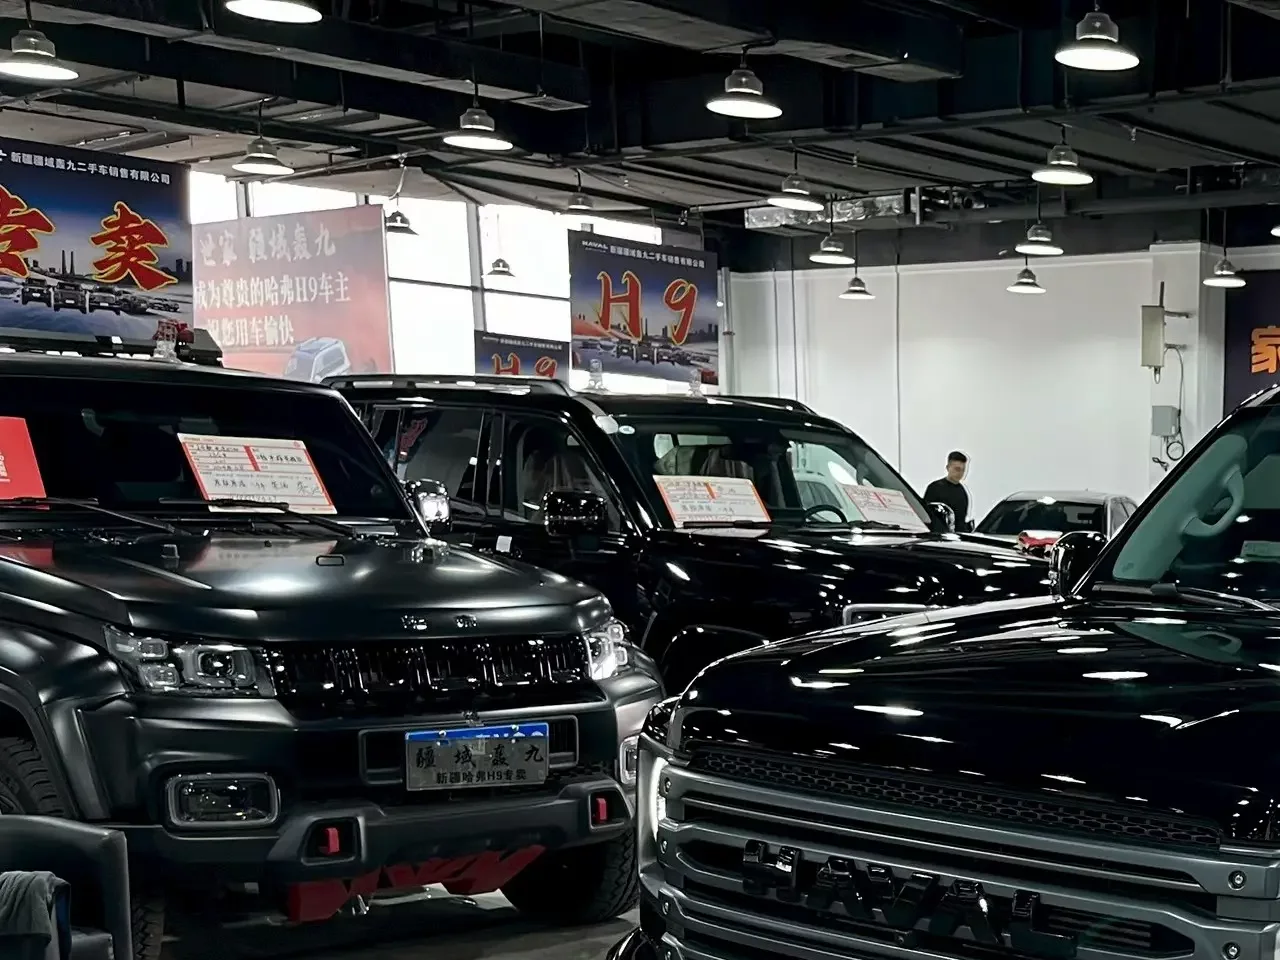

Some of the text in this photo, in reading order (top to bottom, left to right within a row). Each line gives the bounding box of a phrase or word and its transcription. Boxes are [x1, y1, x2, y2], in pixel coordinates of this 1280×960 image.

[436, 768, 527, 785] 新疆哈弗H9专卖
